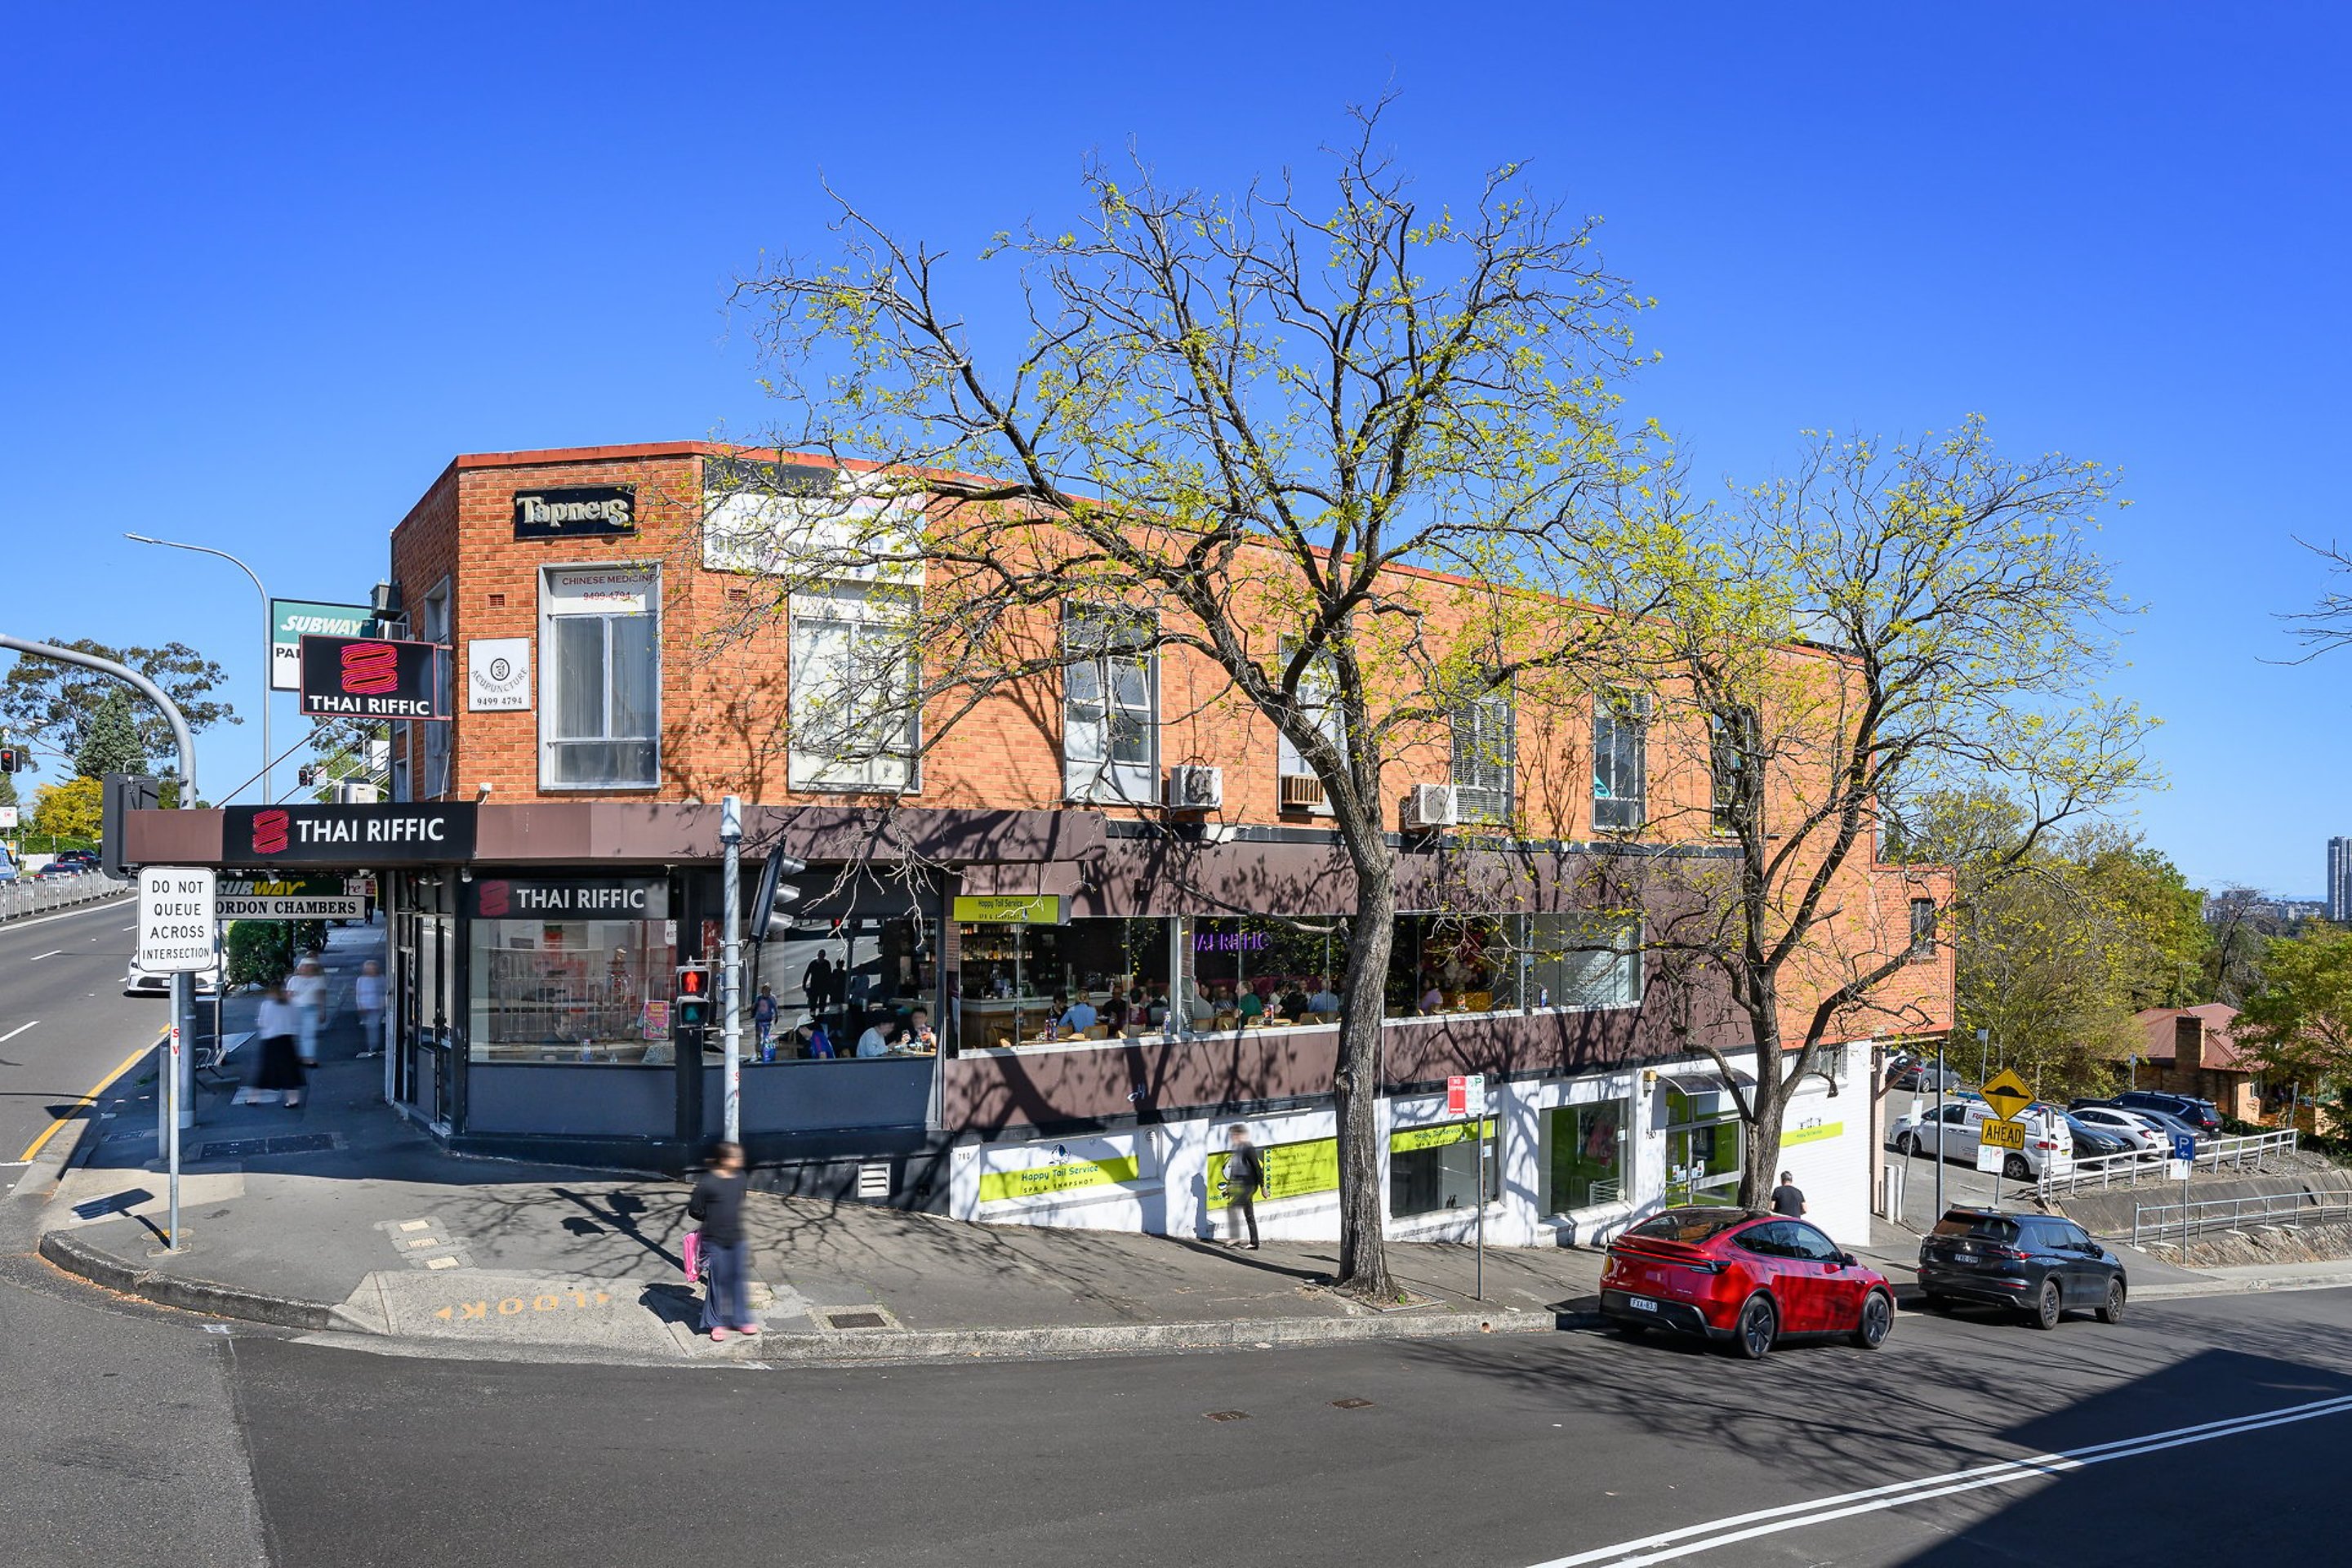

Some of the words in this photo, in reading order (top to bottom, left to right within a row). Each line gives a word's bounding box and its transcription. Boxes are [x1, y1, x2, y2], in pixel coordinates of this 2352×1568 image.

[516, 497, 630, 527] Tapners
[562, 576, 605, 586] CHINESE
[608, 574, 656, 584] MEDICINE
[280, 615, 364, 636] SUBWAY
[471, 667, 528, 693] ACUPUNCTURE
[308, 695, 361, 713] THAI
[368, 699, 430, 715] RIFFIC
[477, 697, 498, 706] 9499
[501, 697, 523, 706] 4794
[296, 819, 358, 842] THAI
[368, 817, 444, 841] RIFFIC
[152, 880, 170, 893] DO
[178, 880, 204, 893] NOT
[216, 880, 306, 896] SUBWAY
[516, 889, 570, 908] THAI
[577, 889, 645, 909] RIFFIC
[154, 903, 202, 916] QUEUE
[216, 901, 268, 914] ORDON
[274, 901, 356, 914] CHAMBERS
[150, 925, 204, 939] ACROSS
[143, 947, 210, 960] INTERSECTION
[1985, 1125, 2022, 1144] AHEAD
[2179, 1137, 2190, 1150] P
[1021, 1172, 1049, 1182] Happy
[1052, 1168, 1067, 1177] Tail
[1068, 1164, 1098, 1175] Service
[1023, 1186, 1038, 1194] SPA
[1053, 1178, 1094, 1189] SNAPSHOT
[461, 1290, 586, 1320] LOOK
